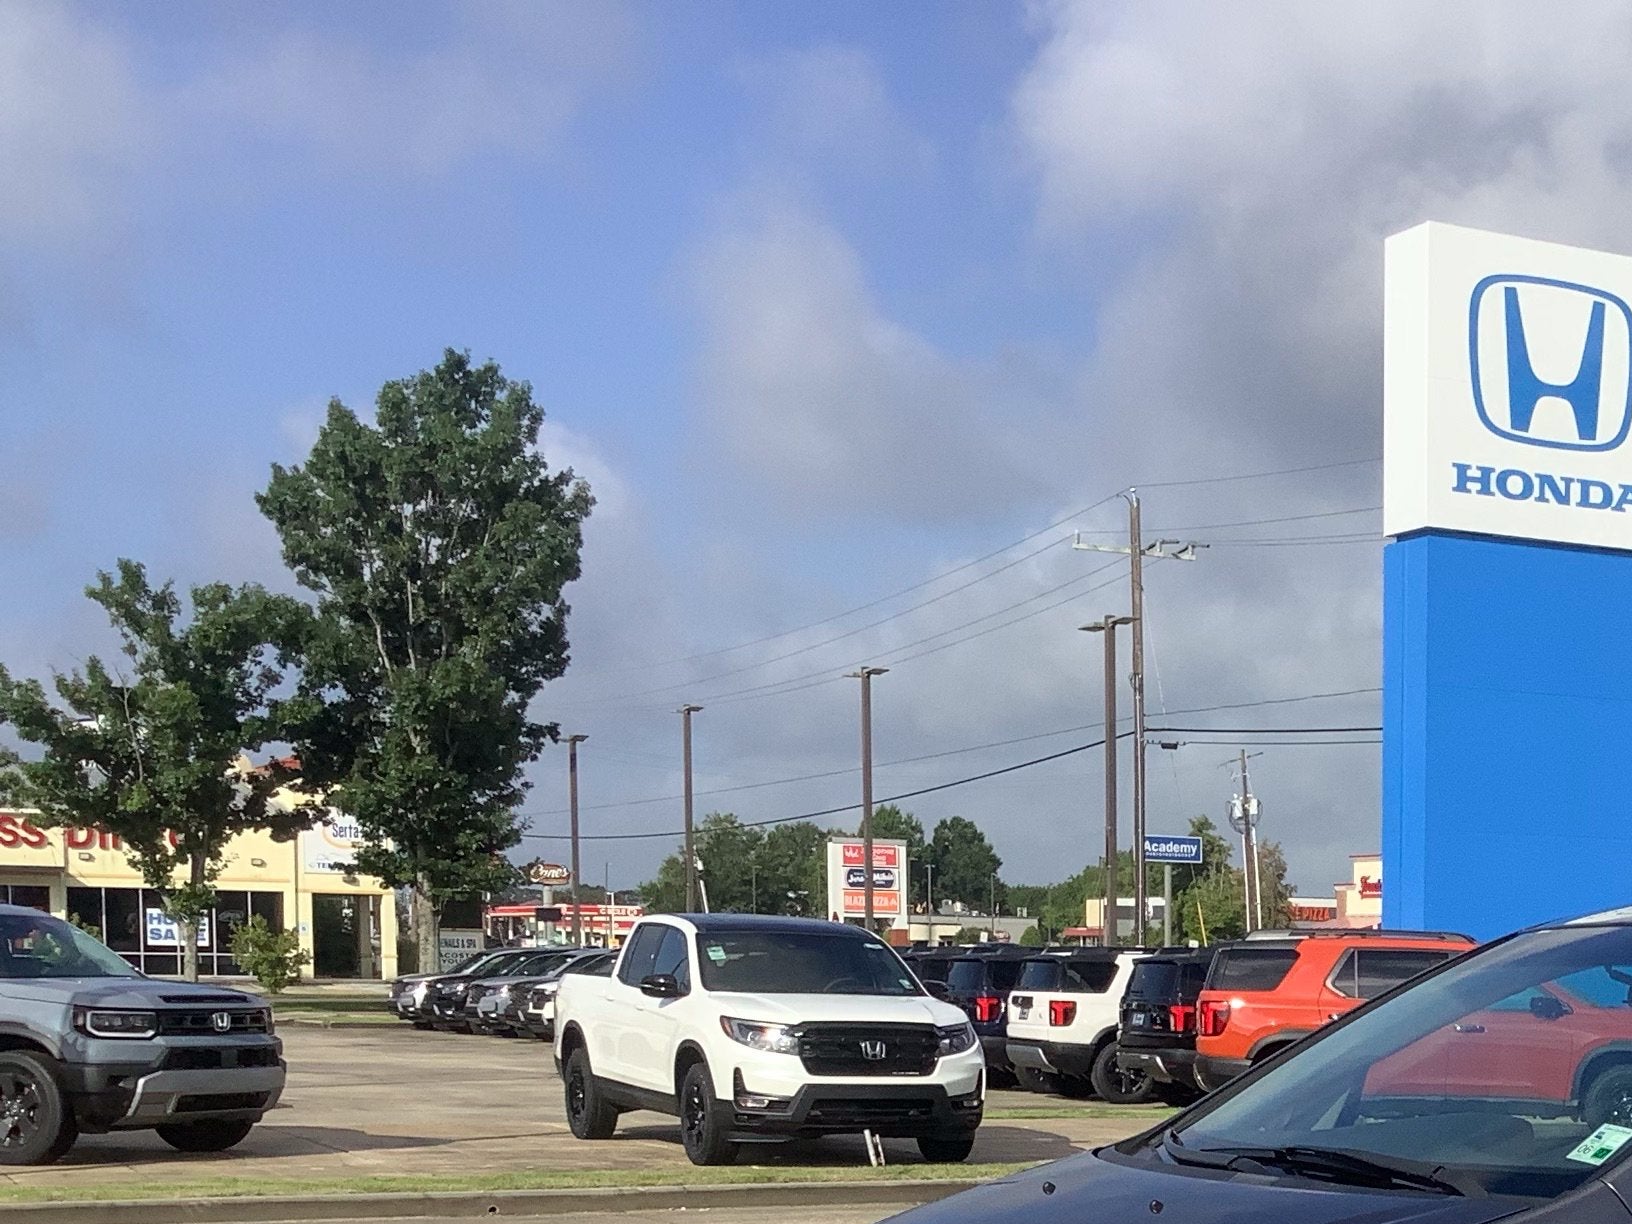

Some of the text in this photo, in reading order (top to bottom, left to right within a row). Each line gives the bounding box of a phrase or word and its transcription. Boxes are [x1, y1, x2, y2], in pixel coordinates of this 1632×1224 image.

[332, 823, 359, 839] Serta
[1144, 840, 1198, 857] Academy
[149, 928, 206, 941] SAE
